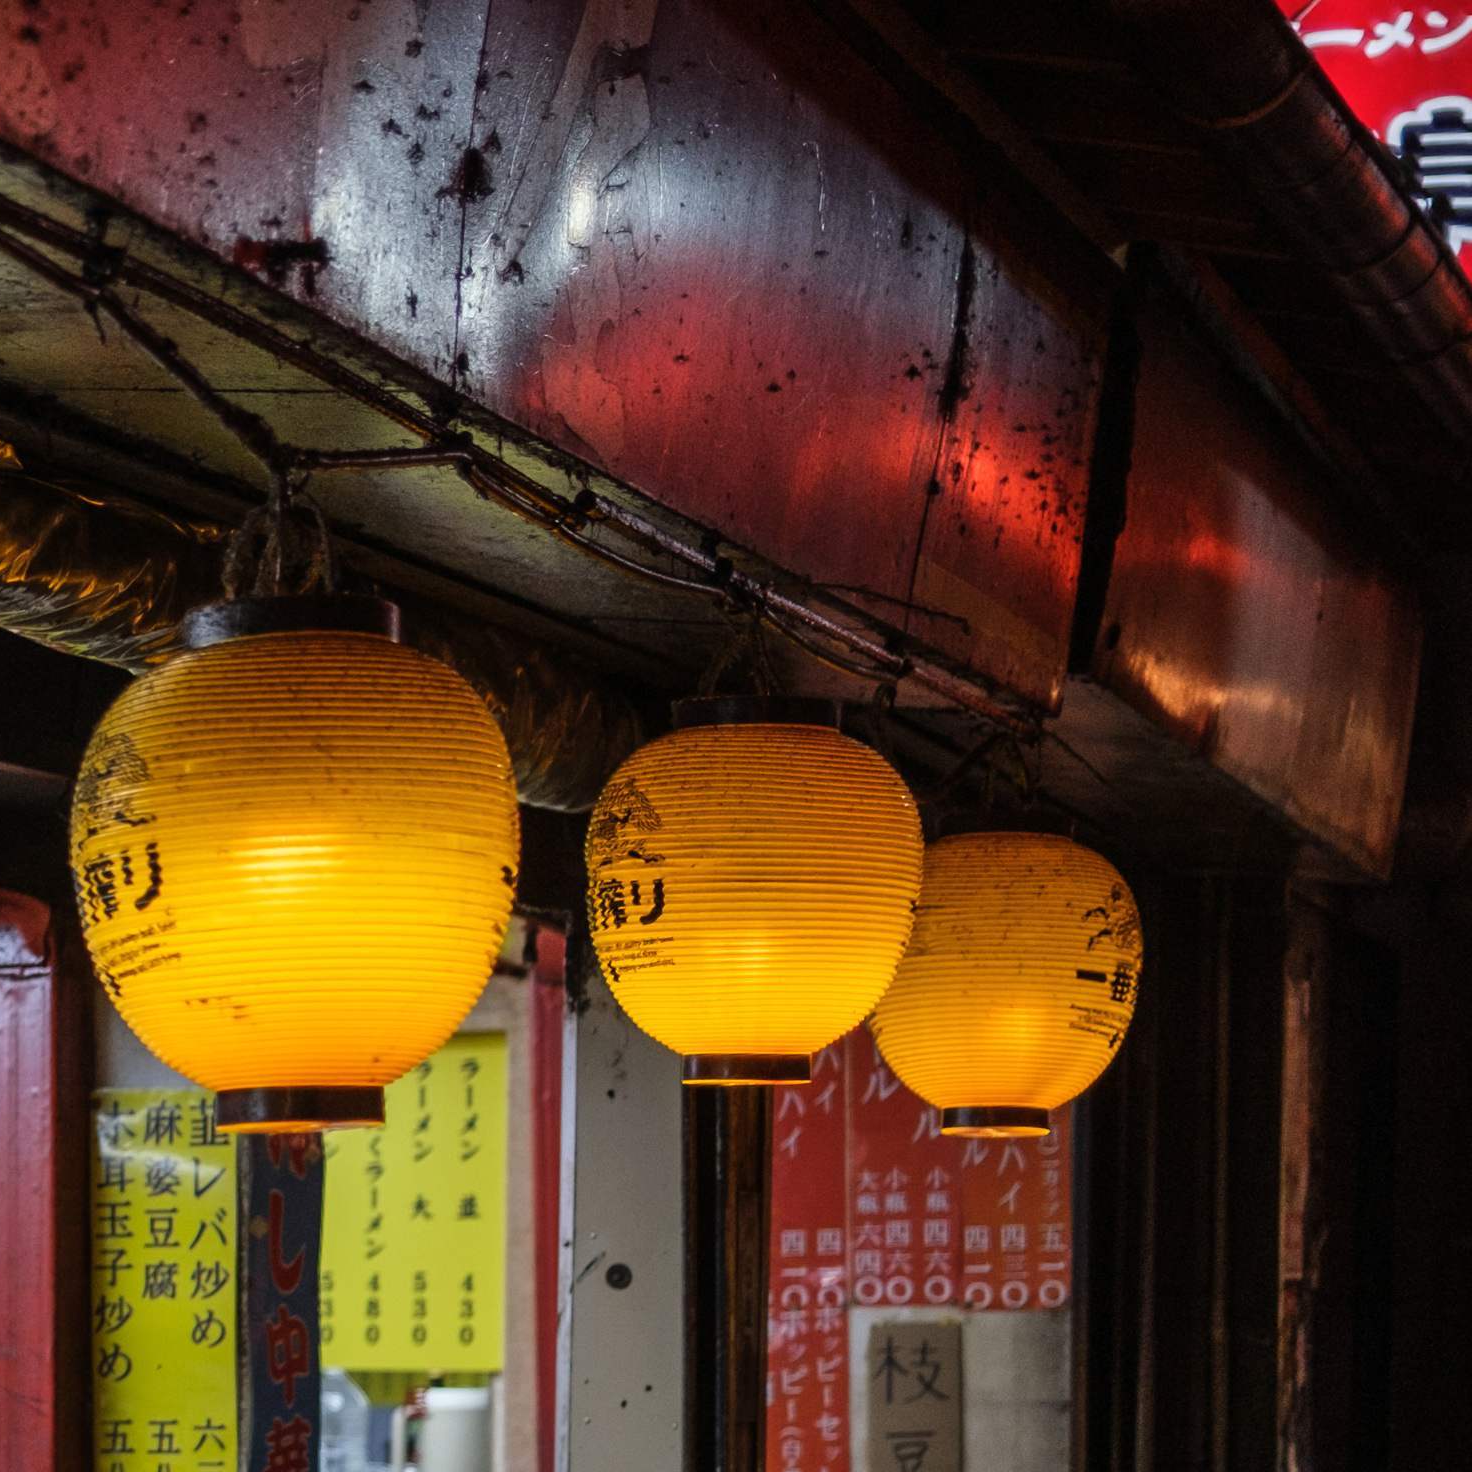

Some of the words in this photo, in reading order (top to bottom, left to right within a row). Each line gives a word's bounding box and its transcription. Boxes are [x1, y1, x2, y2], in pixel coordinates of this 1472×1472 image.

[1291, 11, 1472, 58] ーメン
[461, 1057, 479, 1162] ラーメン
[143, 1102, 183, 1301] 麻婆豆腐
[366, 1273, 380, 1344] 480
[412, 1271, 427, 1344] 530
[459, 1273, 474, 1344] 430
